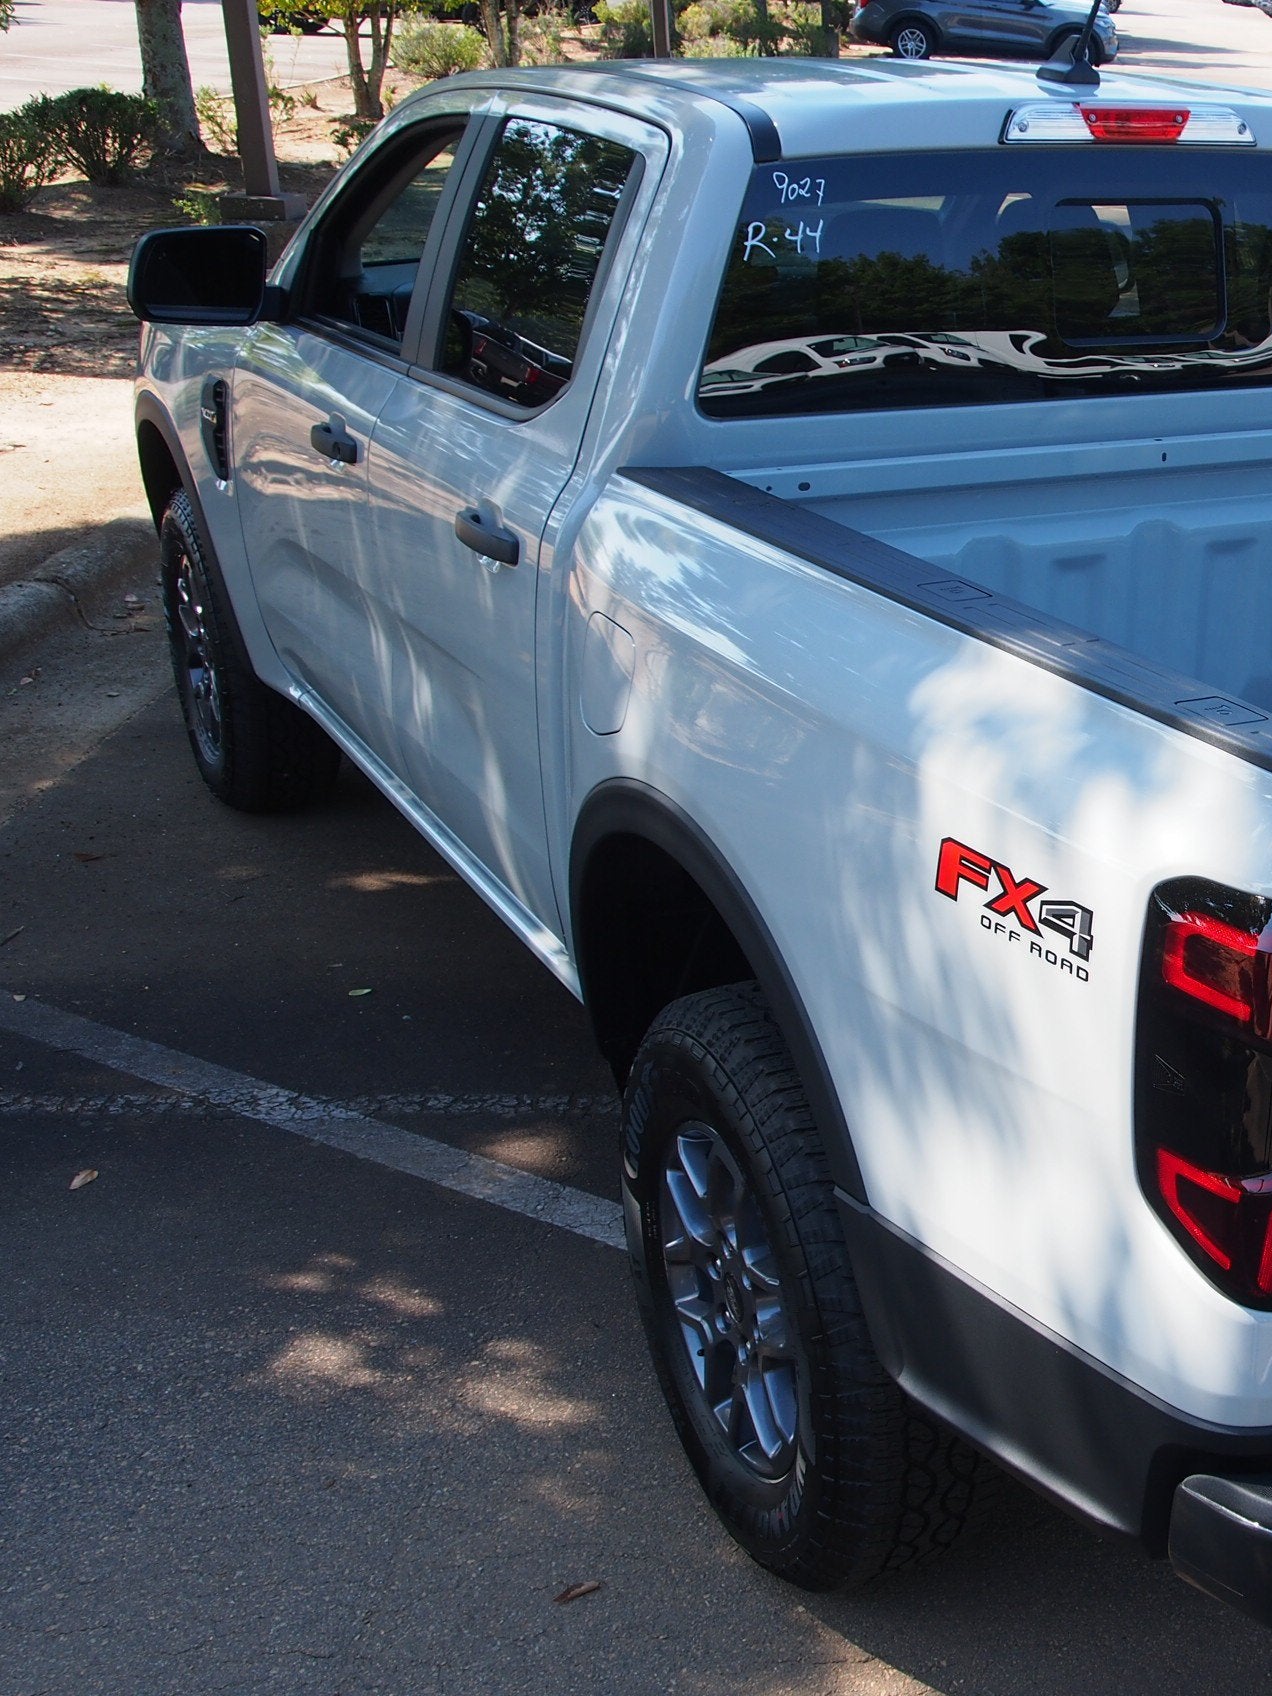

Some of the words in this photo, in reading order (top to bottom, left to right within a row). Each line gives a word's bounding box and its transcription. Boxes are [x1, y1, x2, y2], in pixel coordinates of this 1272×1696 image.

[773, 171, 826, 207] 9027
[935, 836, 1094, 962] FX4
[980, 914, 1021, 942] OFF
[1030, 940, 1089, 982] ROAD
